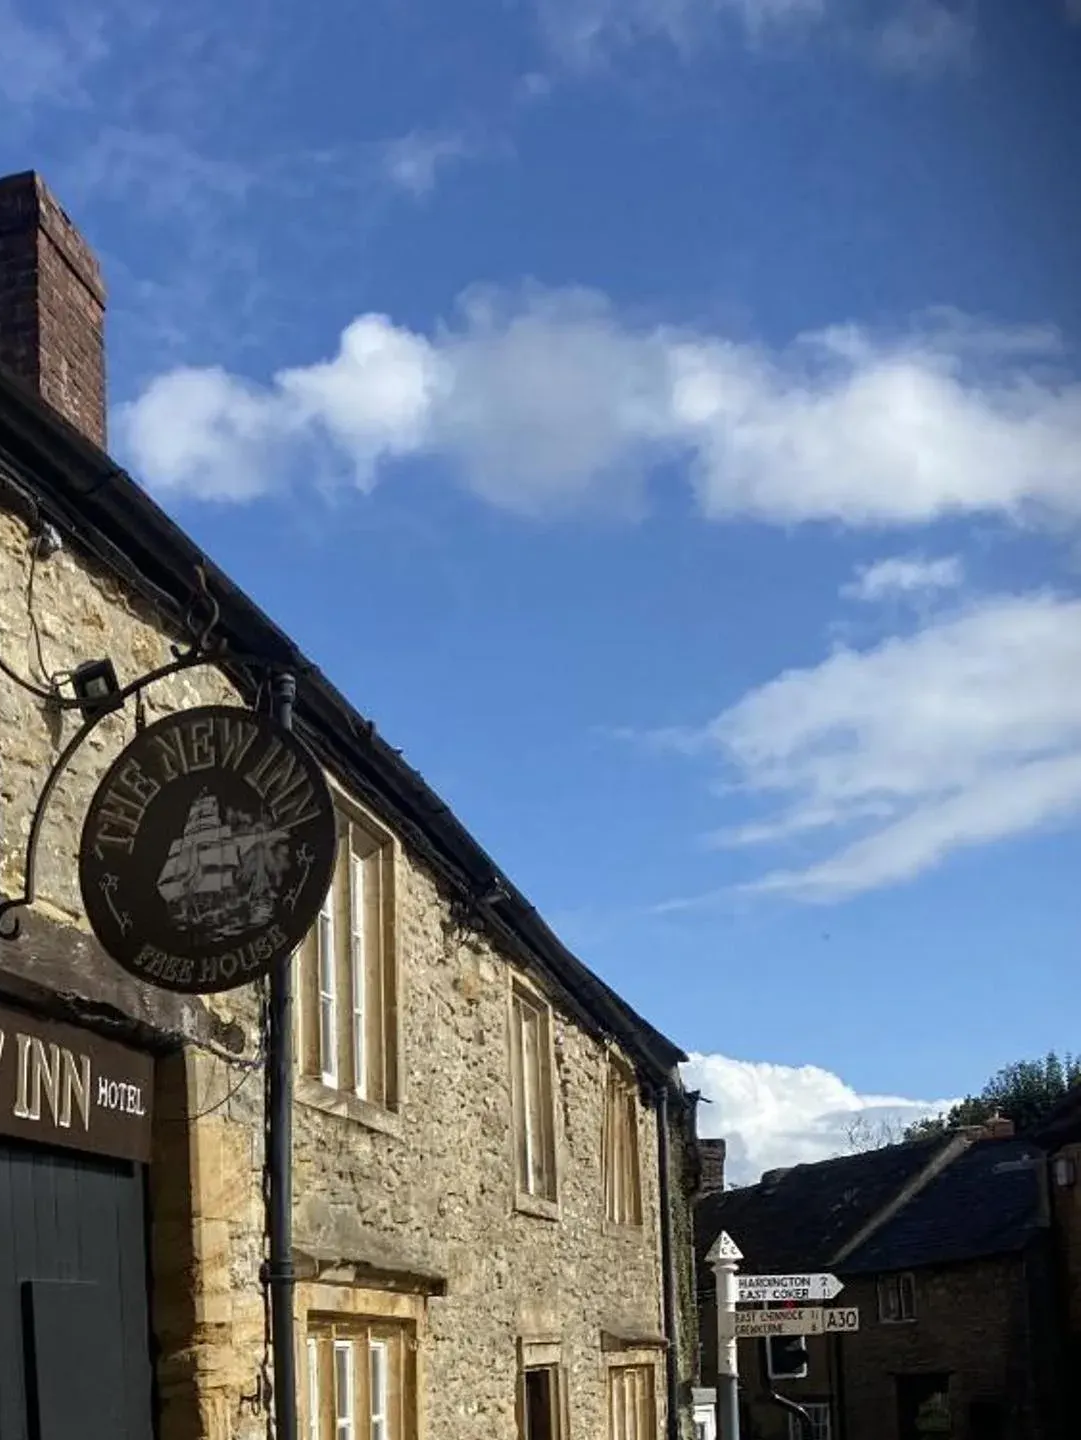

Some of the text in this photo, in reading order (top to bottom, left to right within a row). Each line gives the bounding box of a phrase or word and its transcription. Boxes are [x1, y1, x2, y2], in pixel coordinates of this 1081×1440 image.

[95, 716, 322, 861] THE NEW INN
[132, 924, 289, 984] FREE HOUSE
[13, 1031, 92, 1133] INN
[97, 1076, 146, 1117] HOTEL
[738, 1276, 811, 1289] HARDINGTON
[738, 1288, 767, 1300] EAST
[773, 1287, 809, 1300] COKER
[735, 1311, 755, 1323] EAST
[827, 1311, 858, 1329] A30
